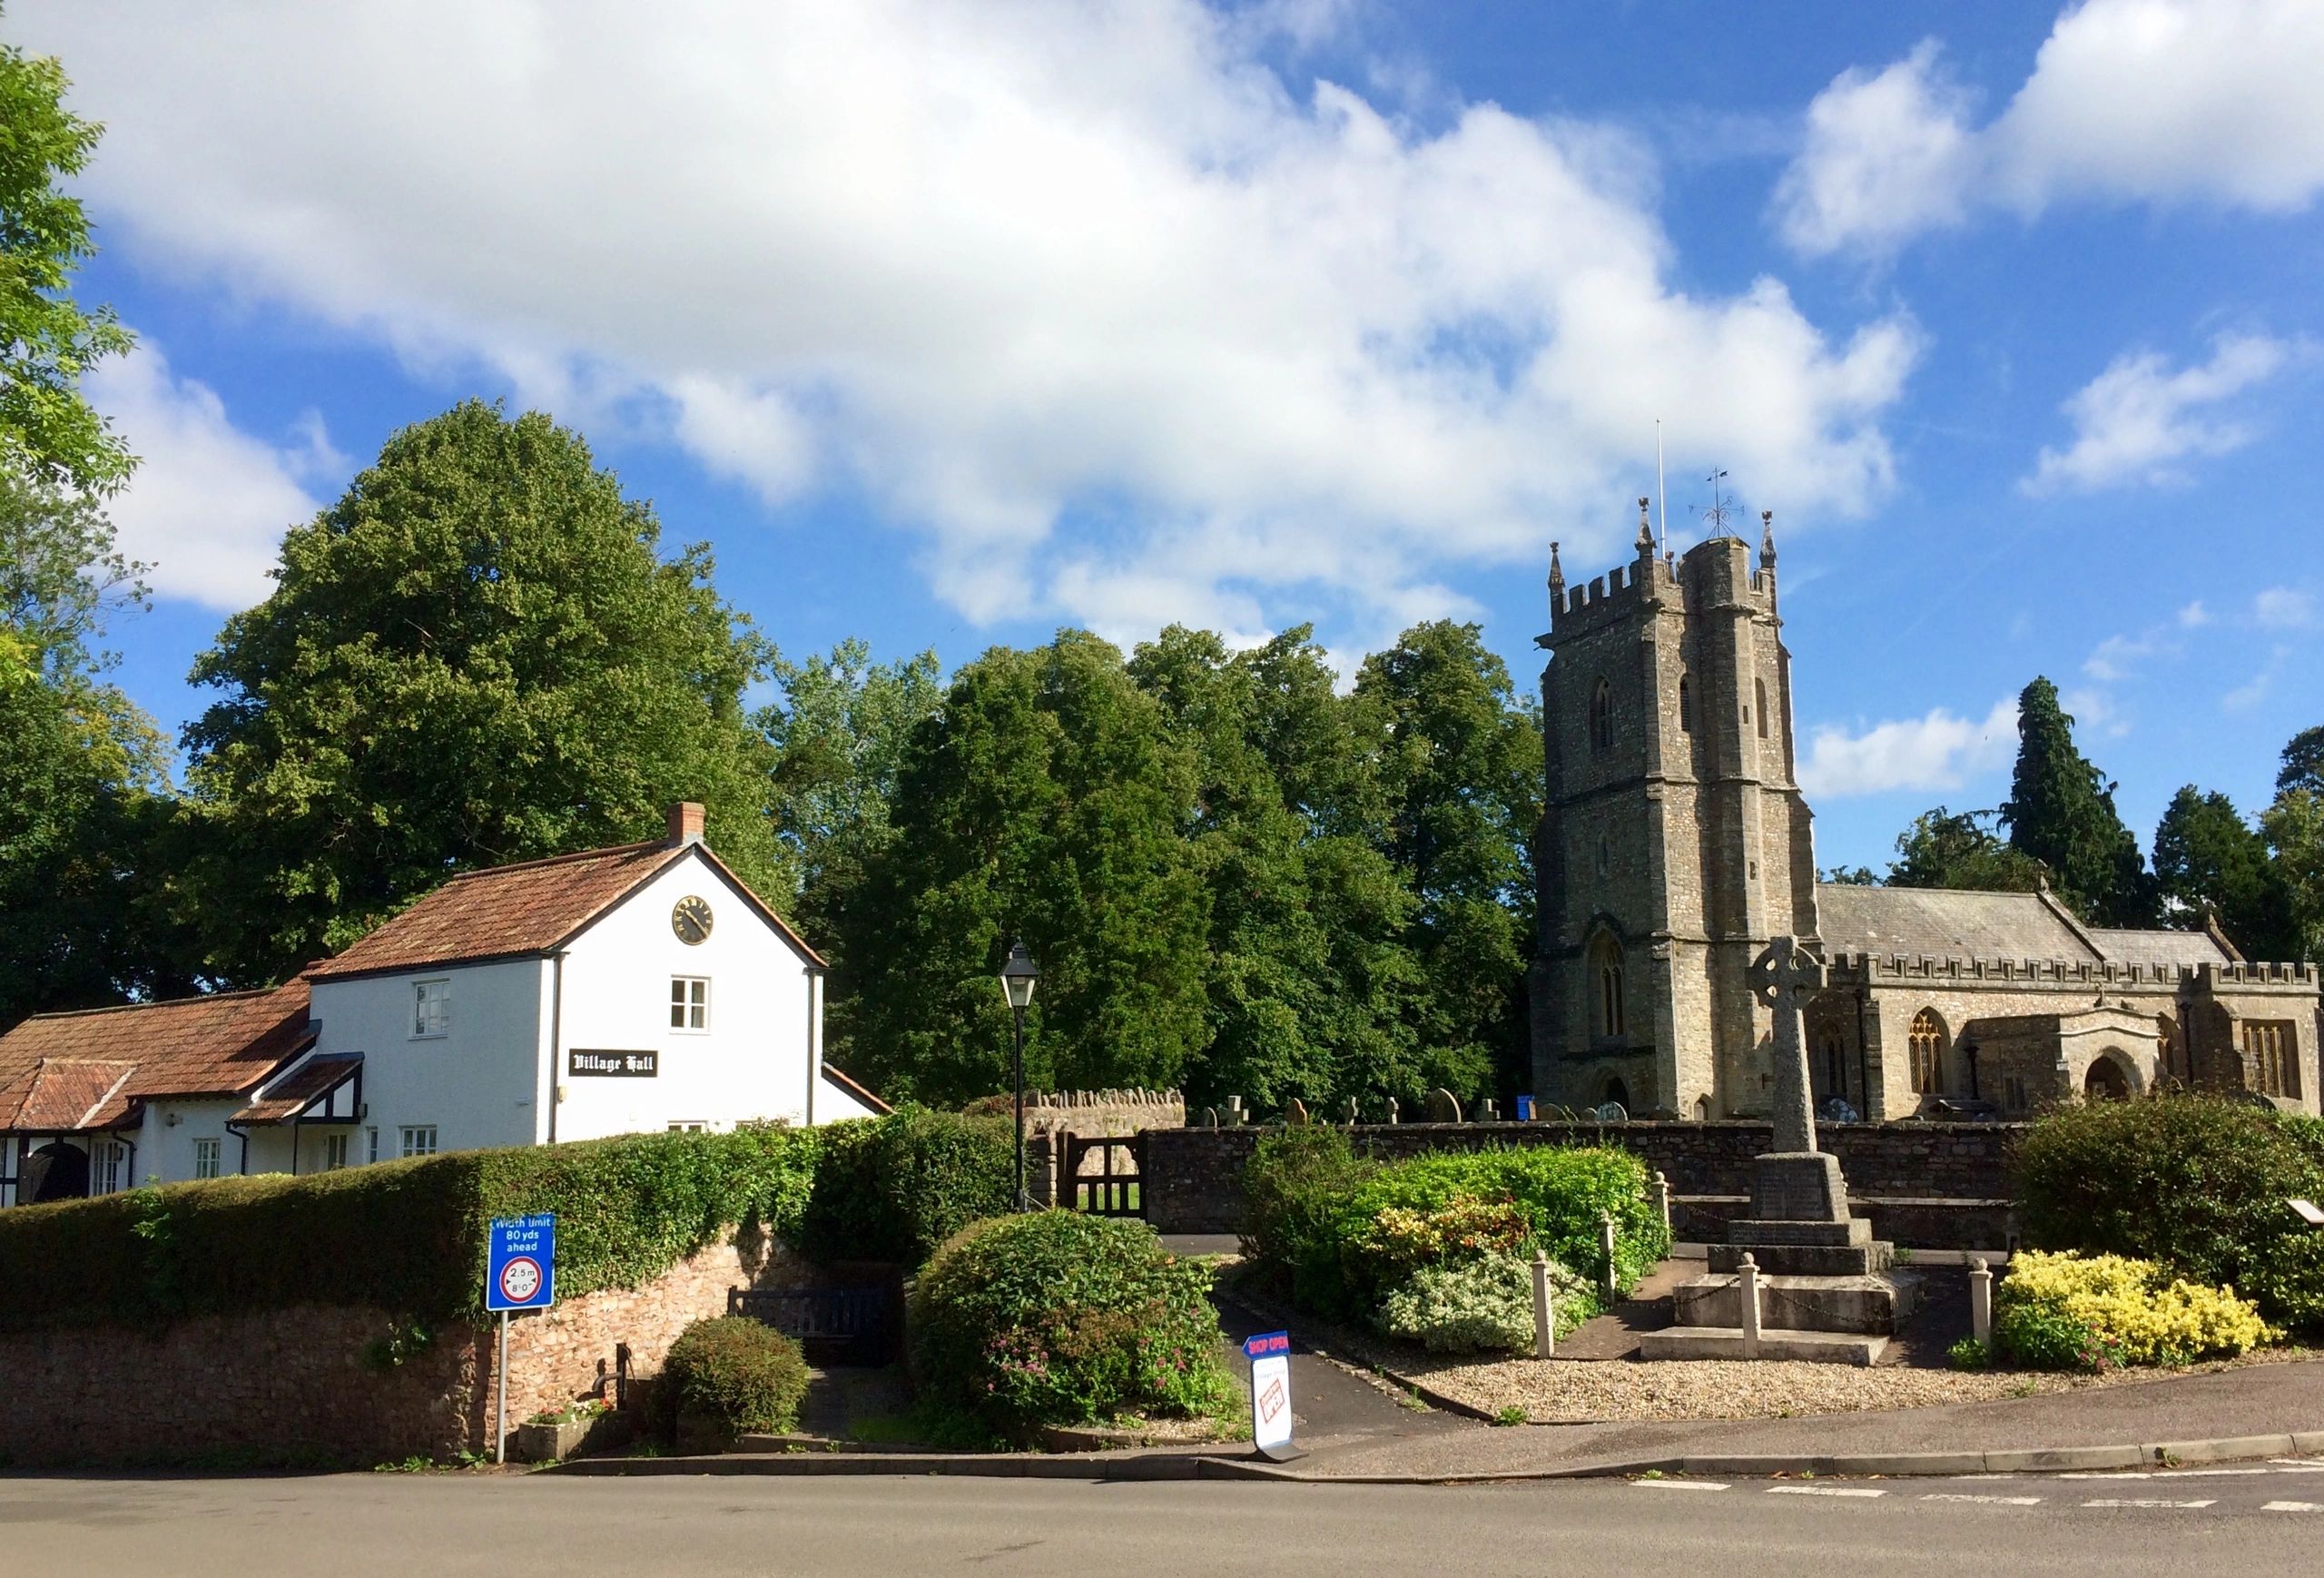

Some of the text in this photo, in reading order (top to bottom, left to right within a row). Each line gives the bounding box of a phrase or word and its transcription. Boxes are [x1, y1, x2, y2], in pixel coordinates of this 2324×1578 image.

[573, 1053, 654, 1073] Village Hall
[506, 1229, 539, 1241] 80 yds
[507, 1241, 537, 1252] ahead
[1248, 1336, 1288, 1355] SHOP OPEN
